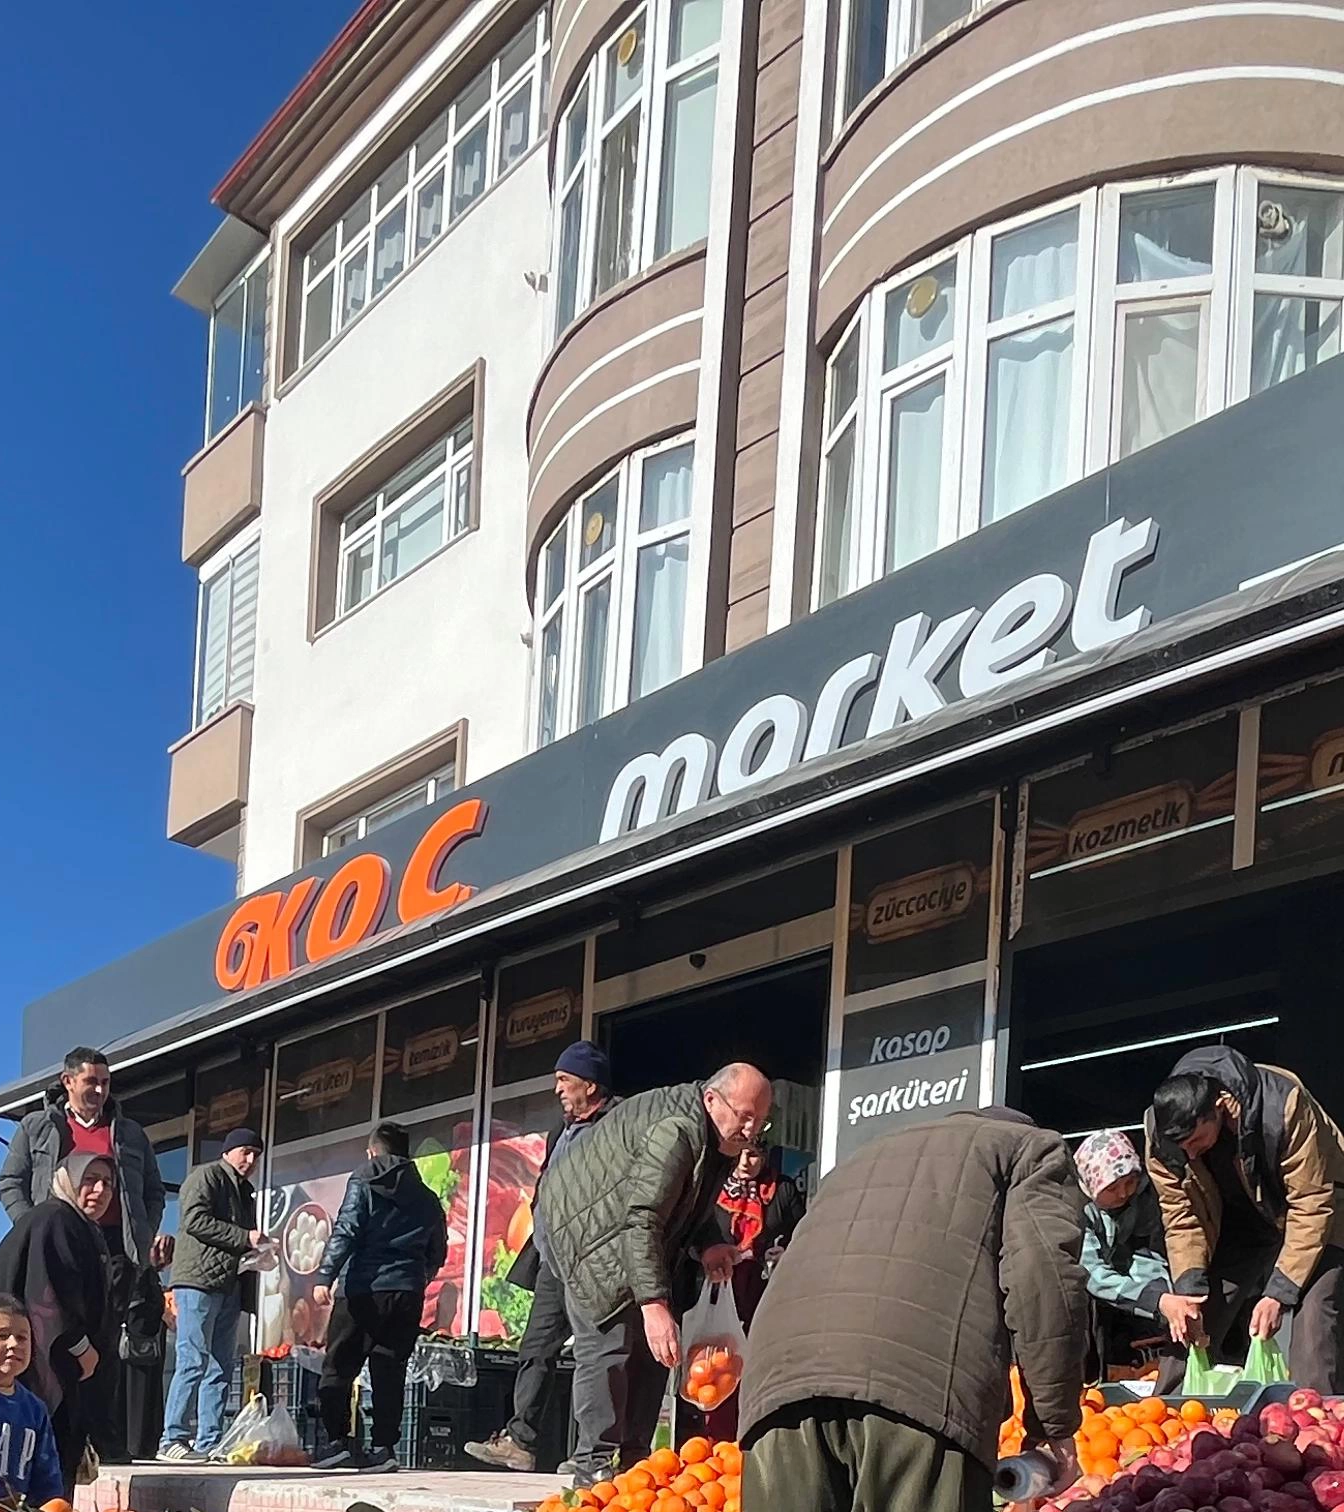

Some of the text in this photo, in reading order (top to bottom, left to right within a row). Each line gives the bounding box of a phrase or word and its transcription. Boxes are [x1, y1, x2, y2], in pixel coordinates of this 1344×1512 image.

[599, 516, 1160, 844] market
[1071, 801, 1185, 856] kozmetik
[872, 879, 967, 926] züccaciye
[869, 1024, 951, 1064] kasap
[847, 1067, 969, 1125] şarküteri
